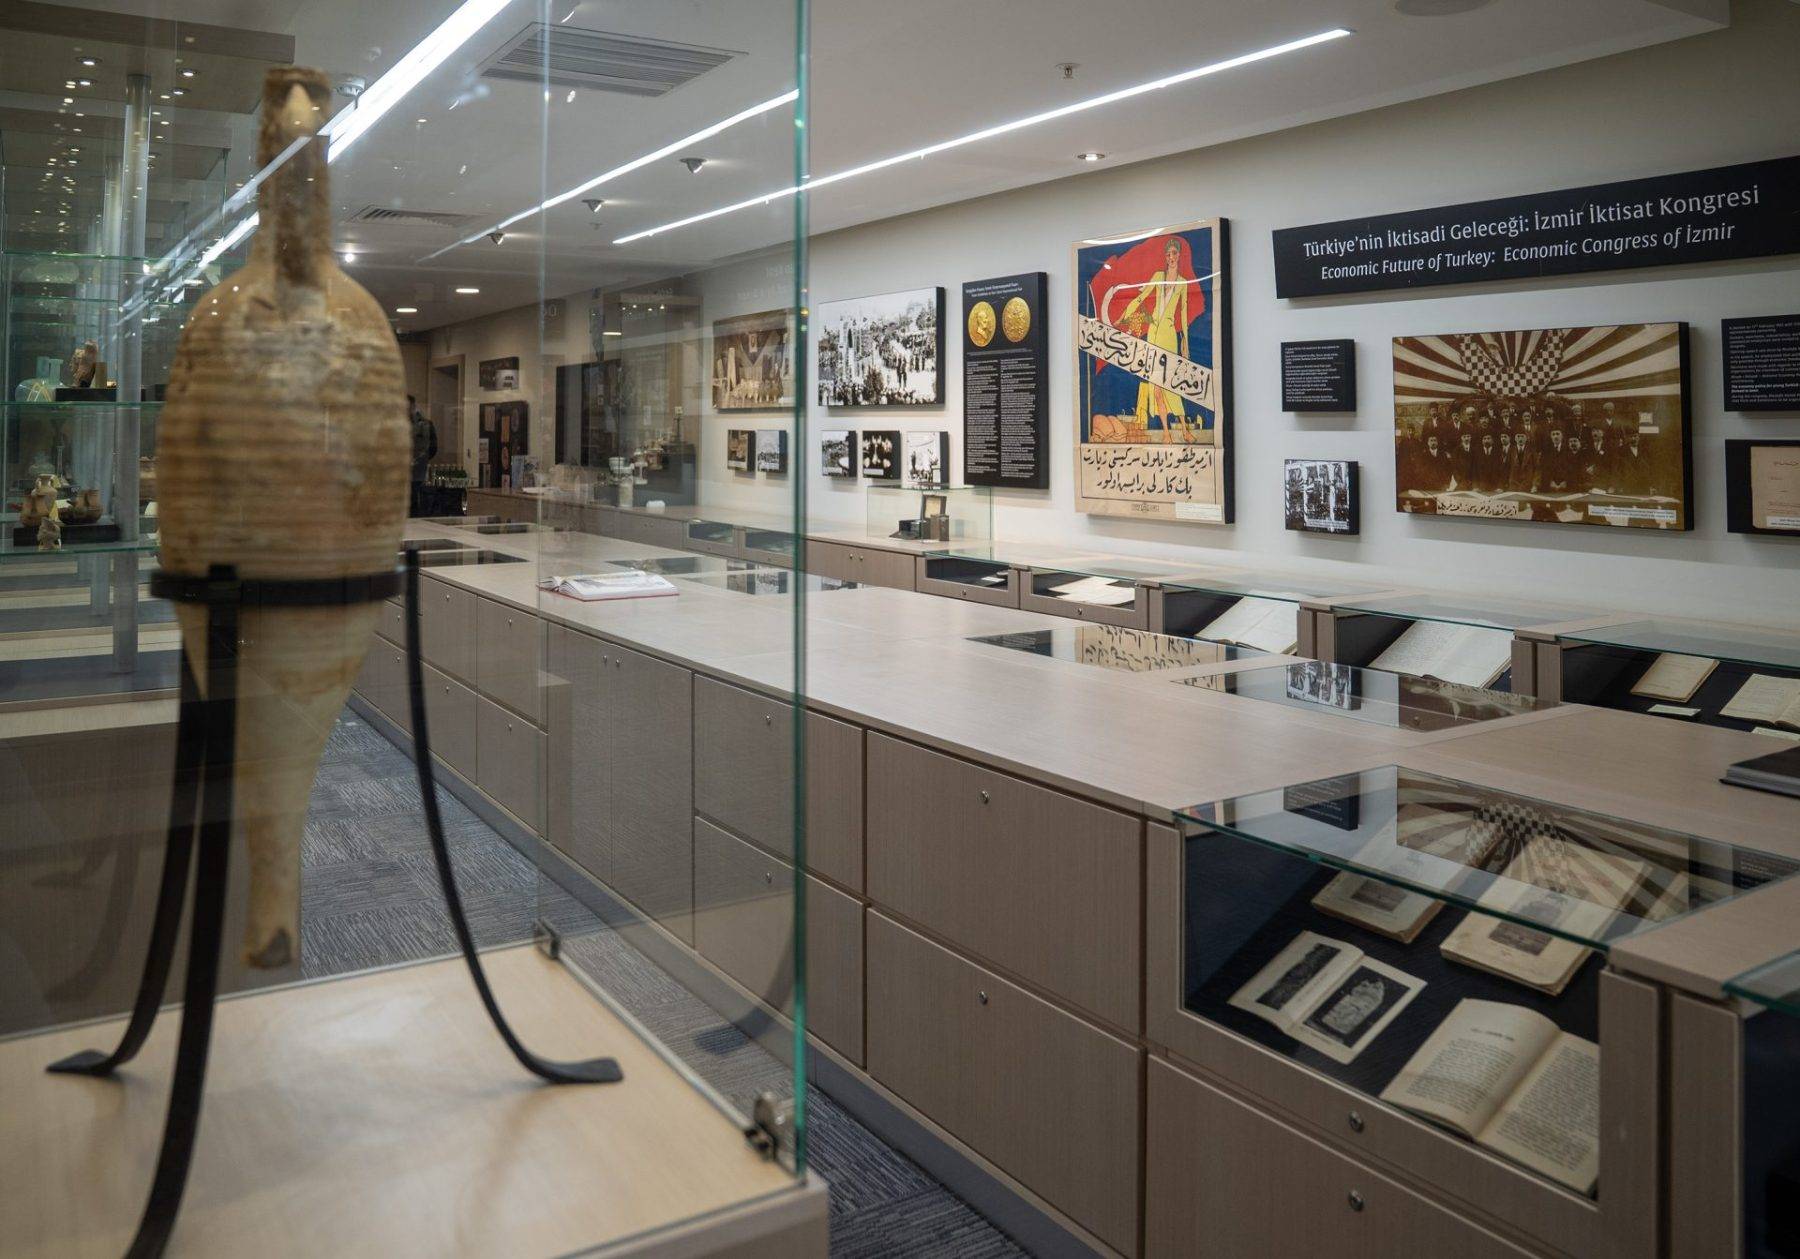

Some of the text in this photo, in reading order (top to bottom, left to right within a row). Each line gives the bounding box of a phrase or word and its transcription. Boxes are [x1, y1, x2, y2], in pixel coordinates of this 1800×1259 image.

[1303, 184, 1760, 257] Türkiye'nin İktisadi Geleceği: İzmir İktisat Kongresi
[1321, 222, 1735, 280] Economic Future of Turkey: Economic Congress of İzmir
